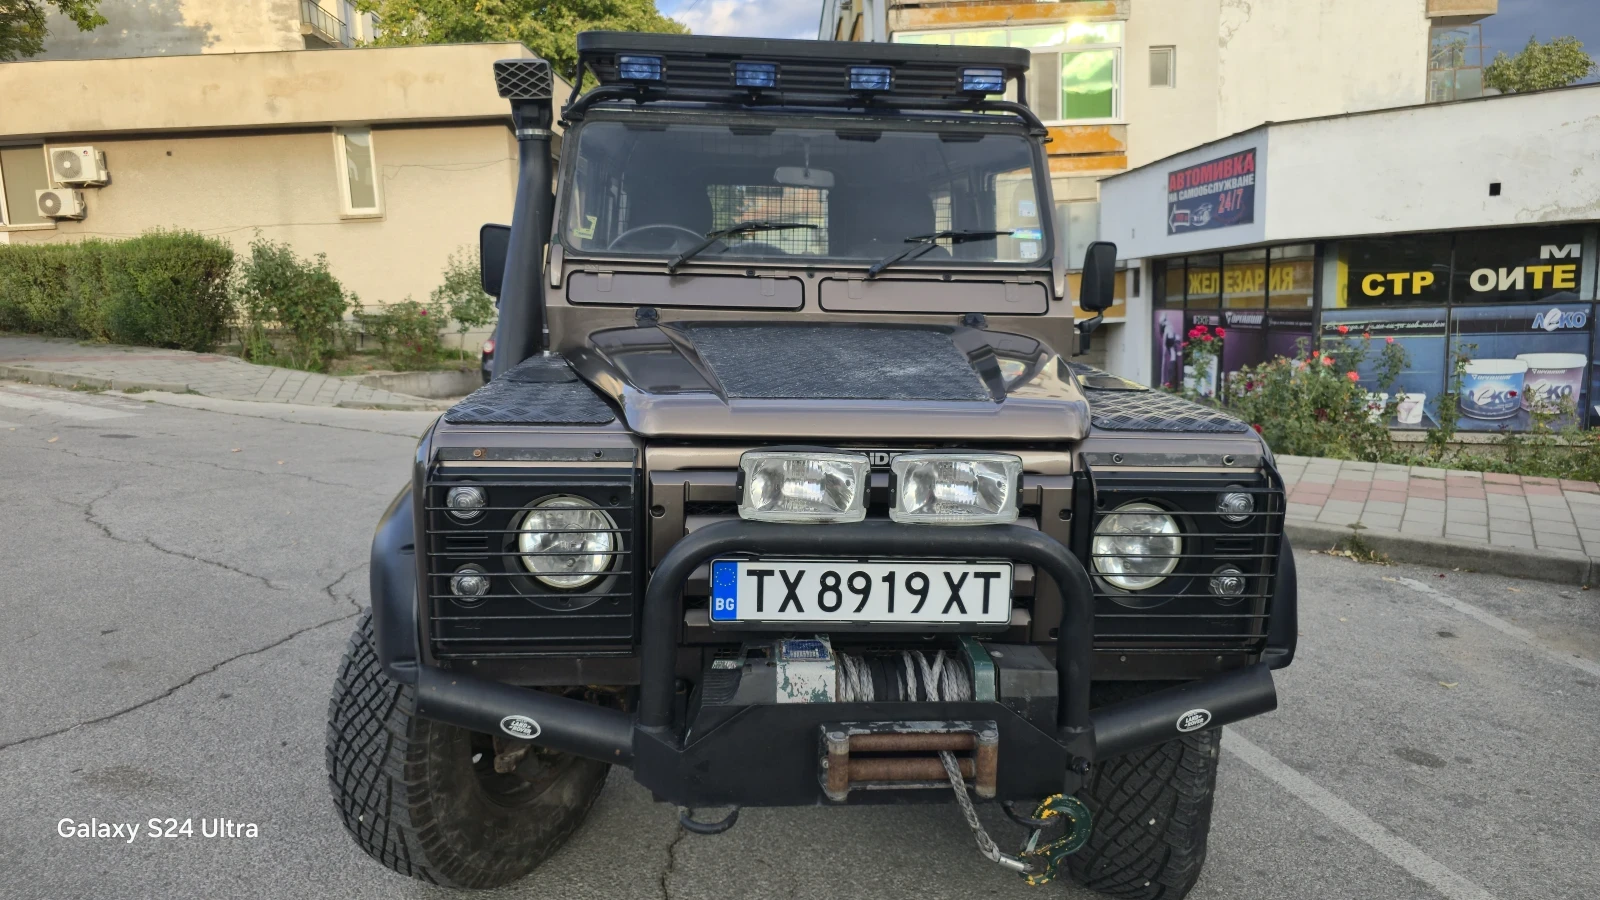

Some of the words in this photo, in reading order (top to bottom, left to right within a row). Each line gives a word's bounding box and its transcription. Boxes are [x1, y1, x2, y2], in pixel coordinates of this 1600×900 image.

[1169, 152, 1254, 192] АВТОМИВКА
[1168, 192, 1178, 203] НА
[1179, 173, 1255, 201] САМООБСЛУЖВАНЕ
[1217, 188, 1244, 214] 24/7
[715, 597, 735, 611] BG
[746, 569, 806, 613] TX
[817, 570, 930, 614] 8919
[941, 571, 1002, 615] XT
